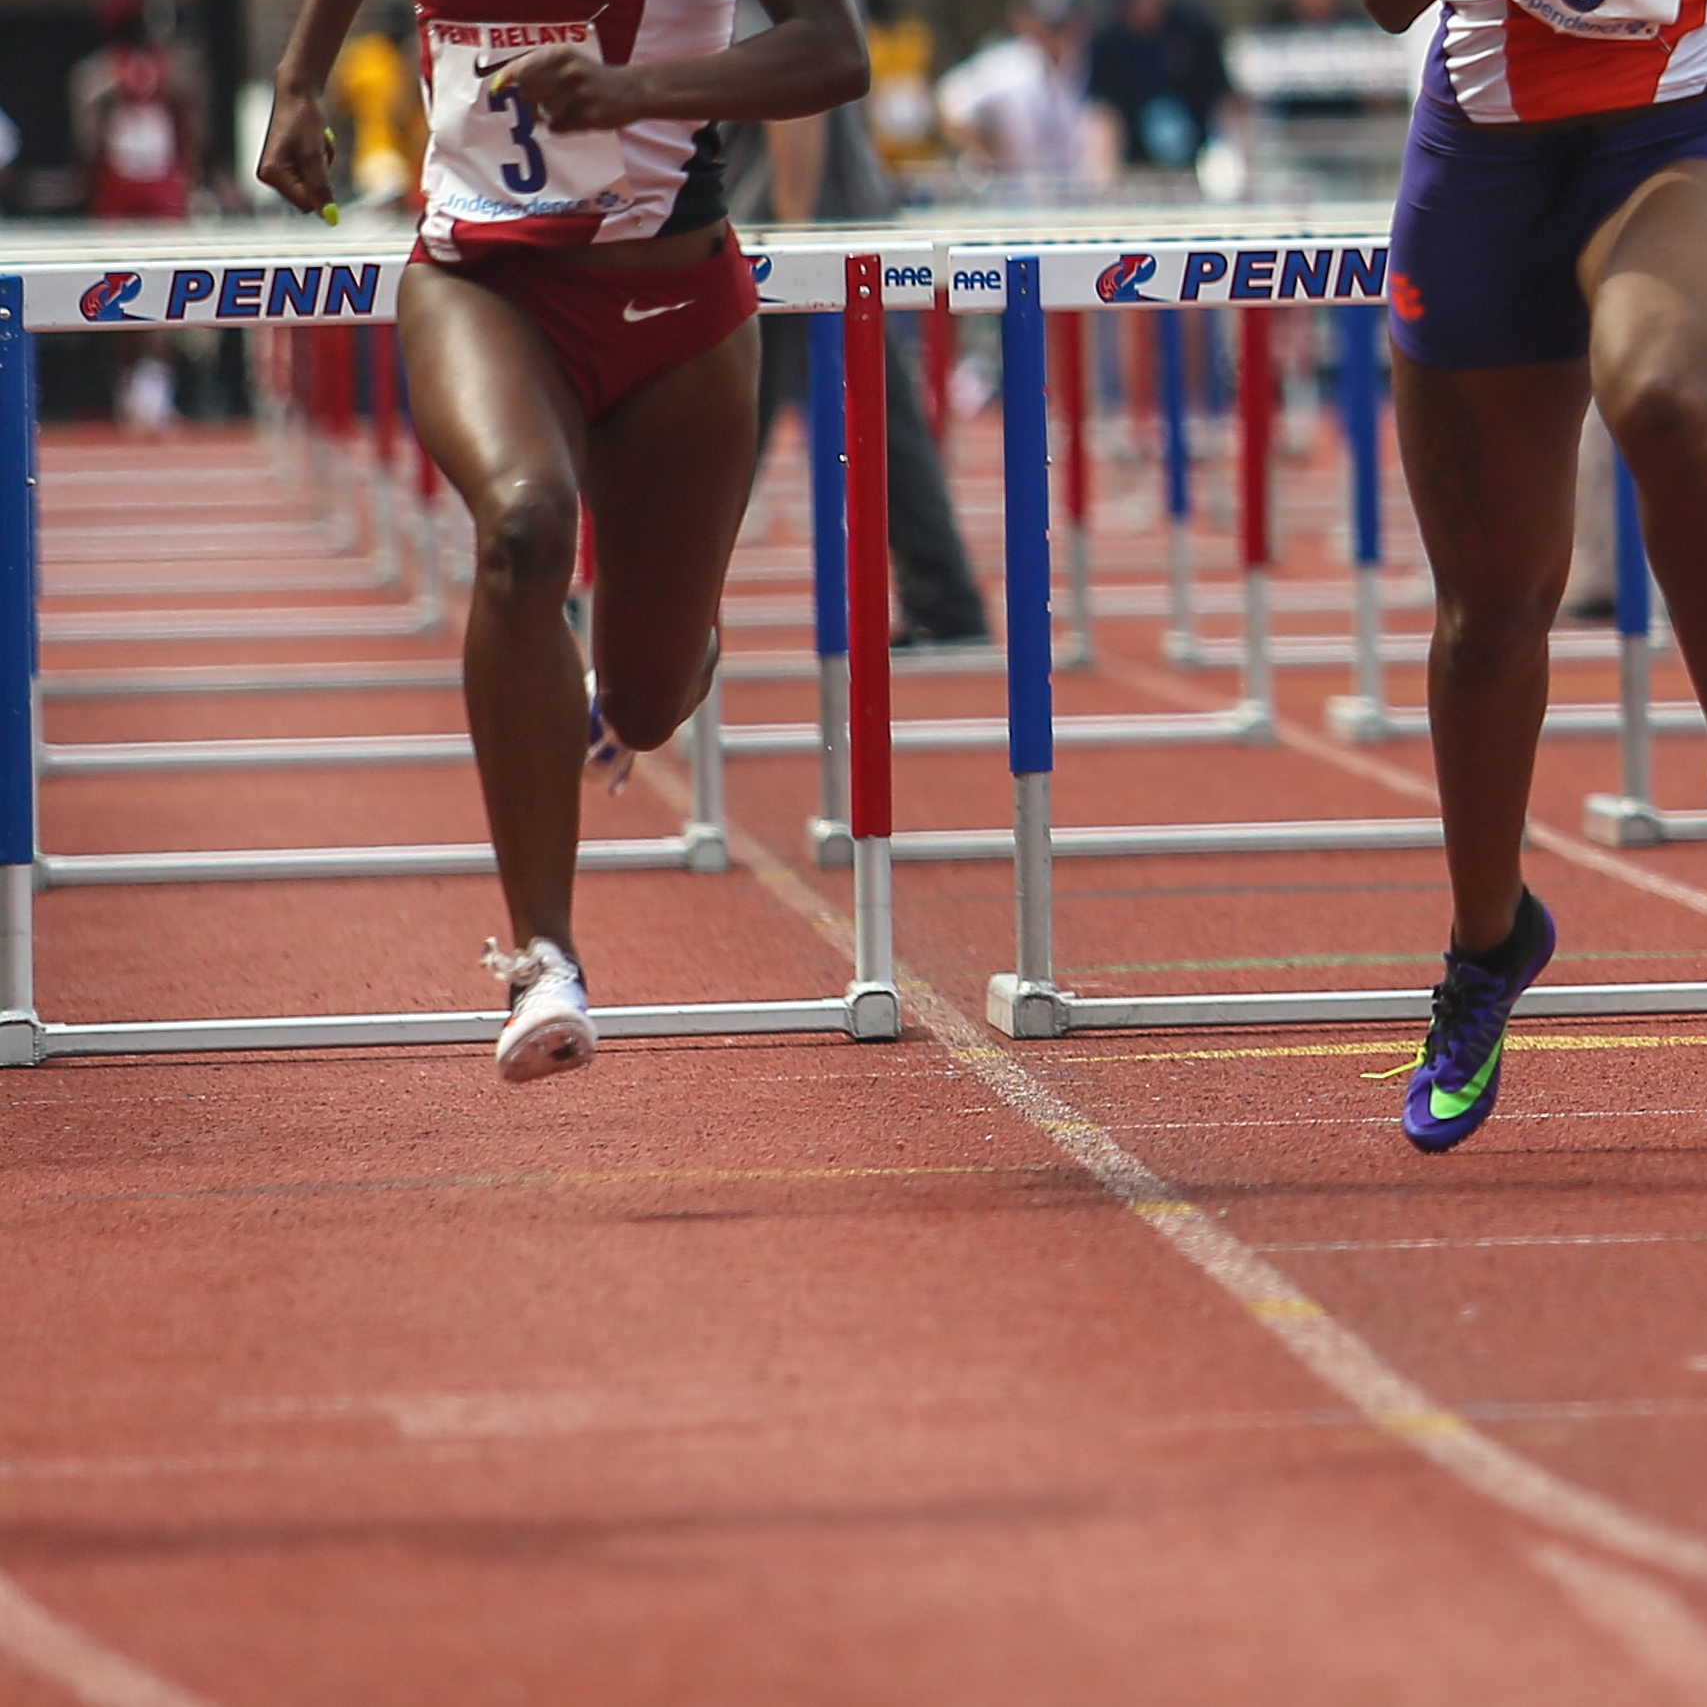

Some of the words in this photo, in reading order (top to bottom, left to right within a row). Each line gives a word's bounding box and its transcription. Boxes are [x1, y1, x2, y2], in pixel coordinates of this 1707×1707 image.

[489, 23, 588, 49] RELAYS
[488, 84, 548, 195] 3
[165, 263, 381, 321] PENN
[1178, 248, 1389, 302] PENN
